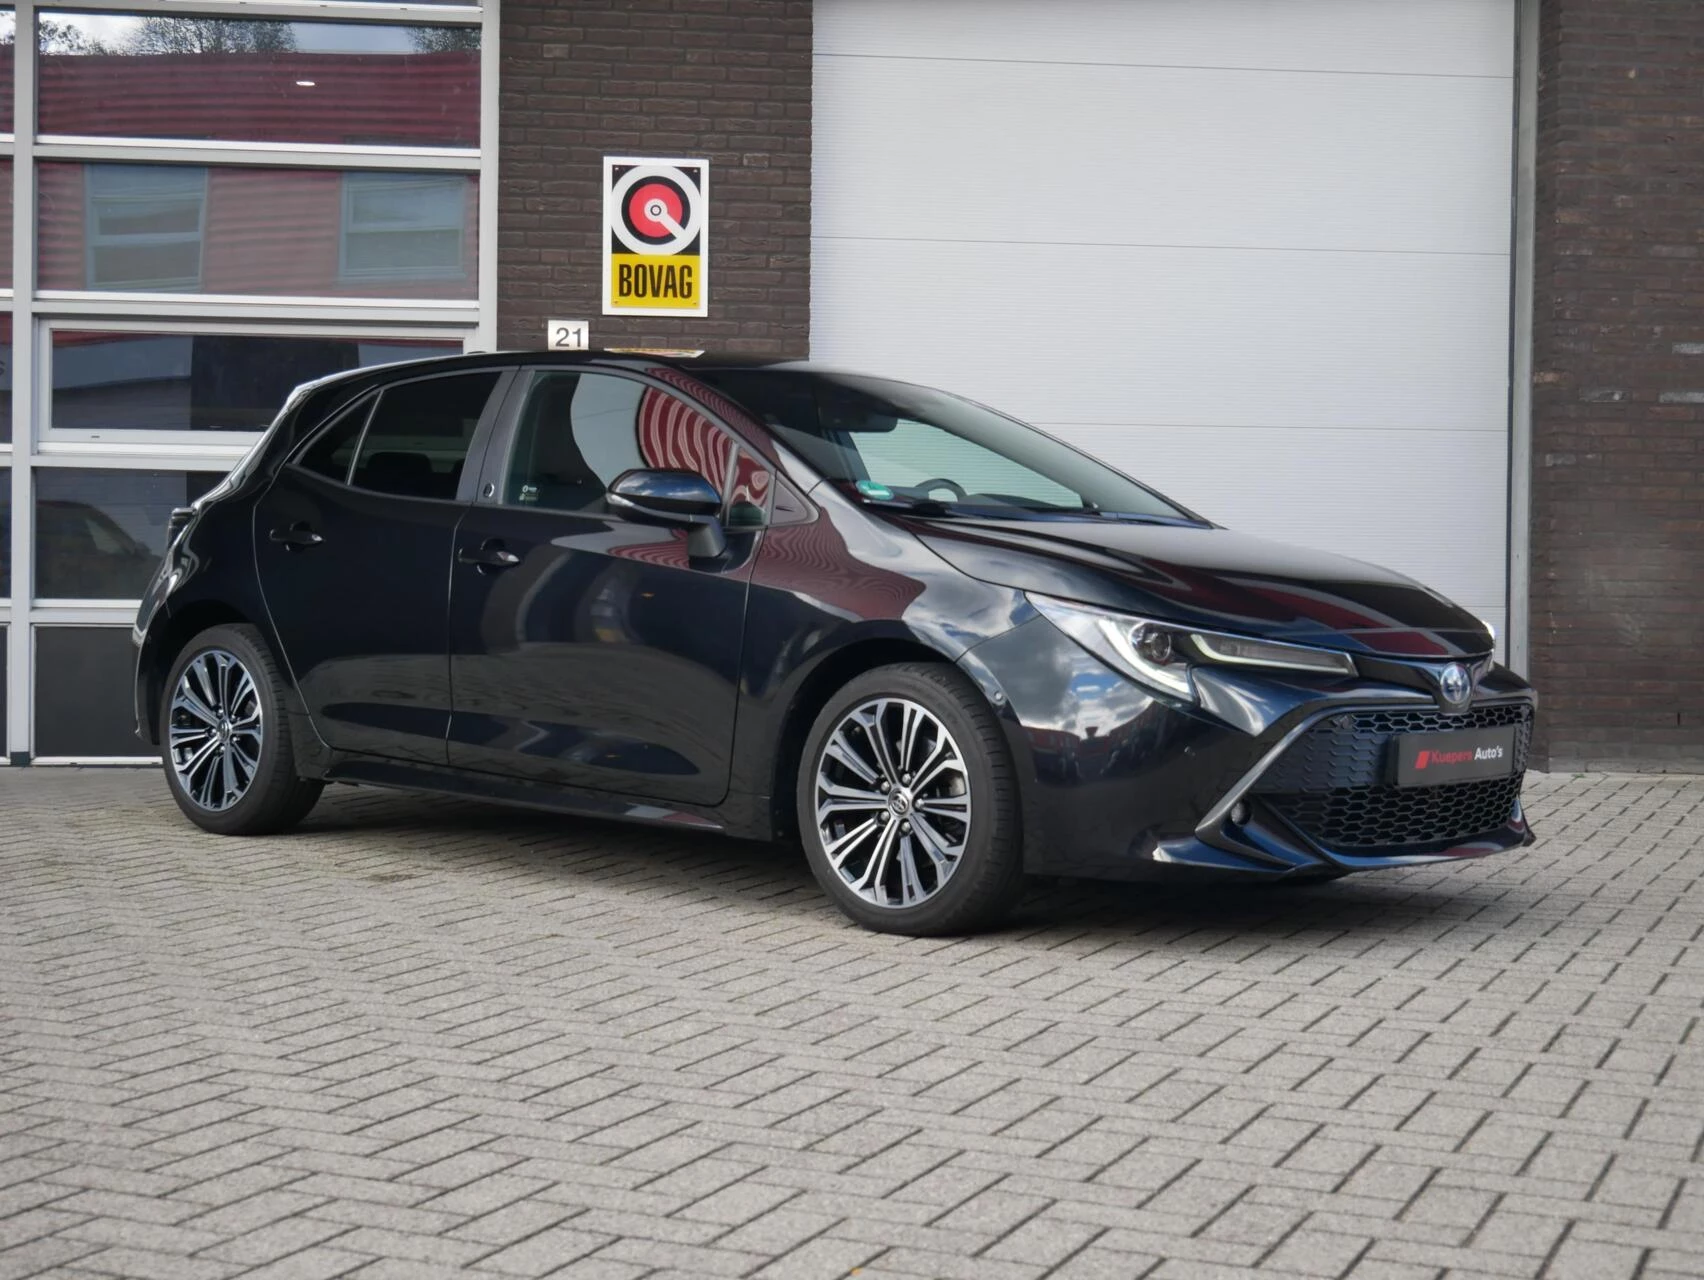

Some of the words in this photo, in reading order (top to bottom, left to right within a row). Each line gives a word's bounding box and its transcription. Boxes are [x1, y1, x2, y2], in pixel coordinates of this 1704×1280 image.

[618, 263, 693, 299] BOVAG
[555, 327, 582, 347] 21
[1474, 745, 1504, 760] Auto's
